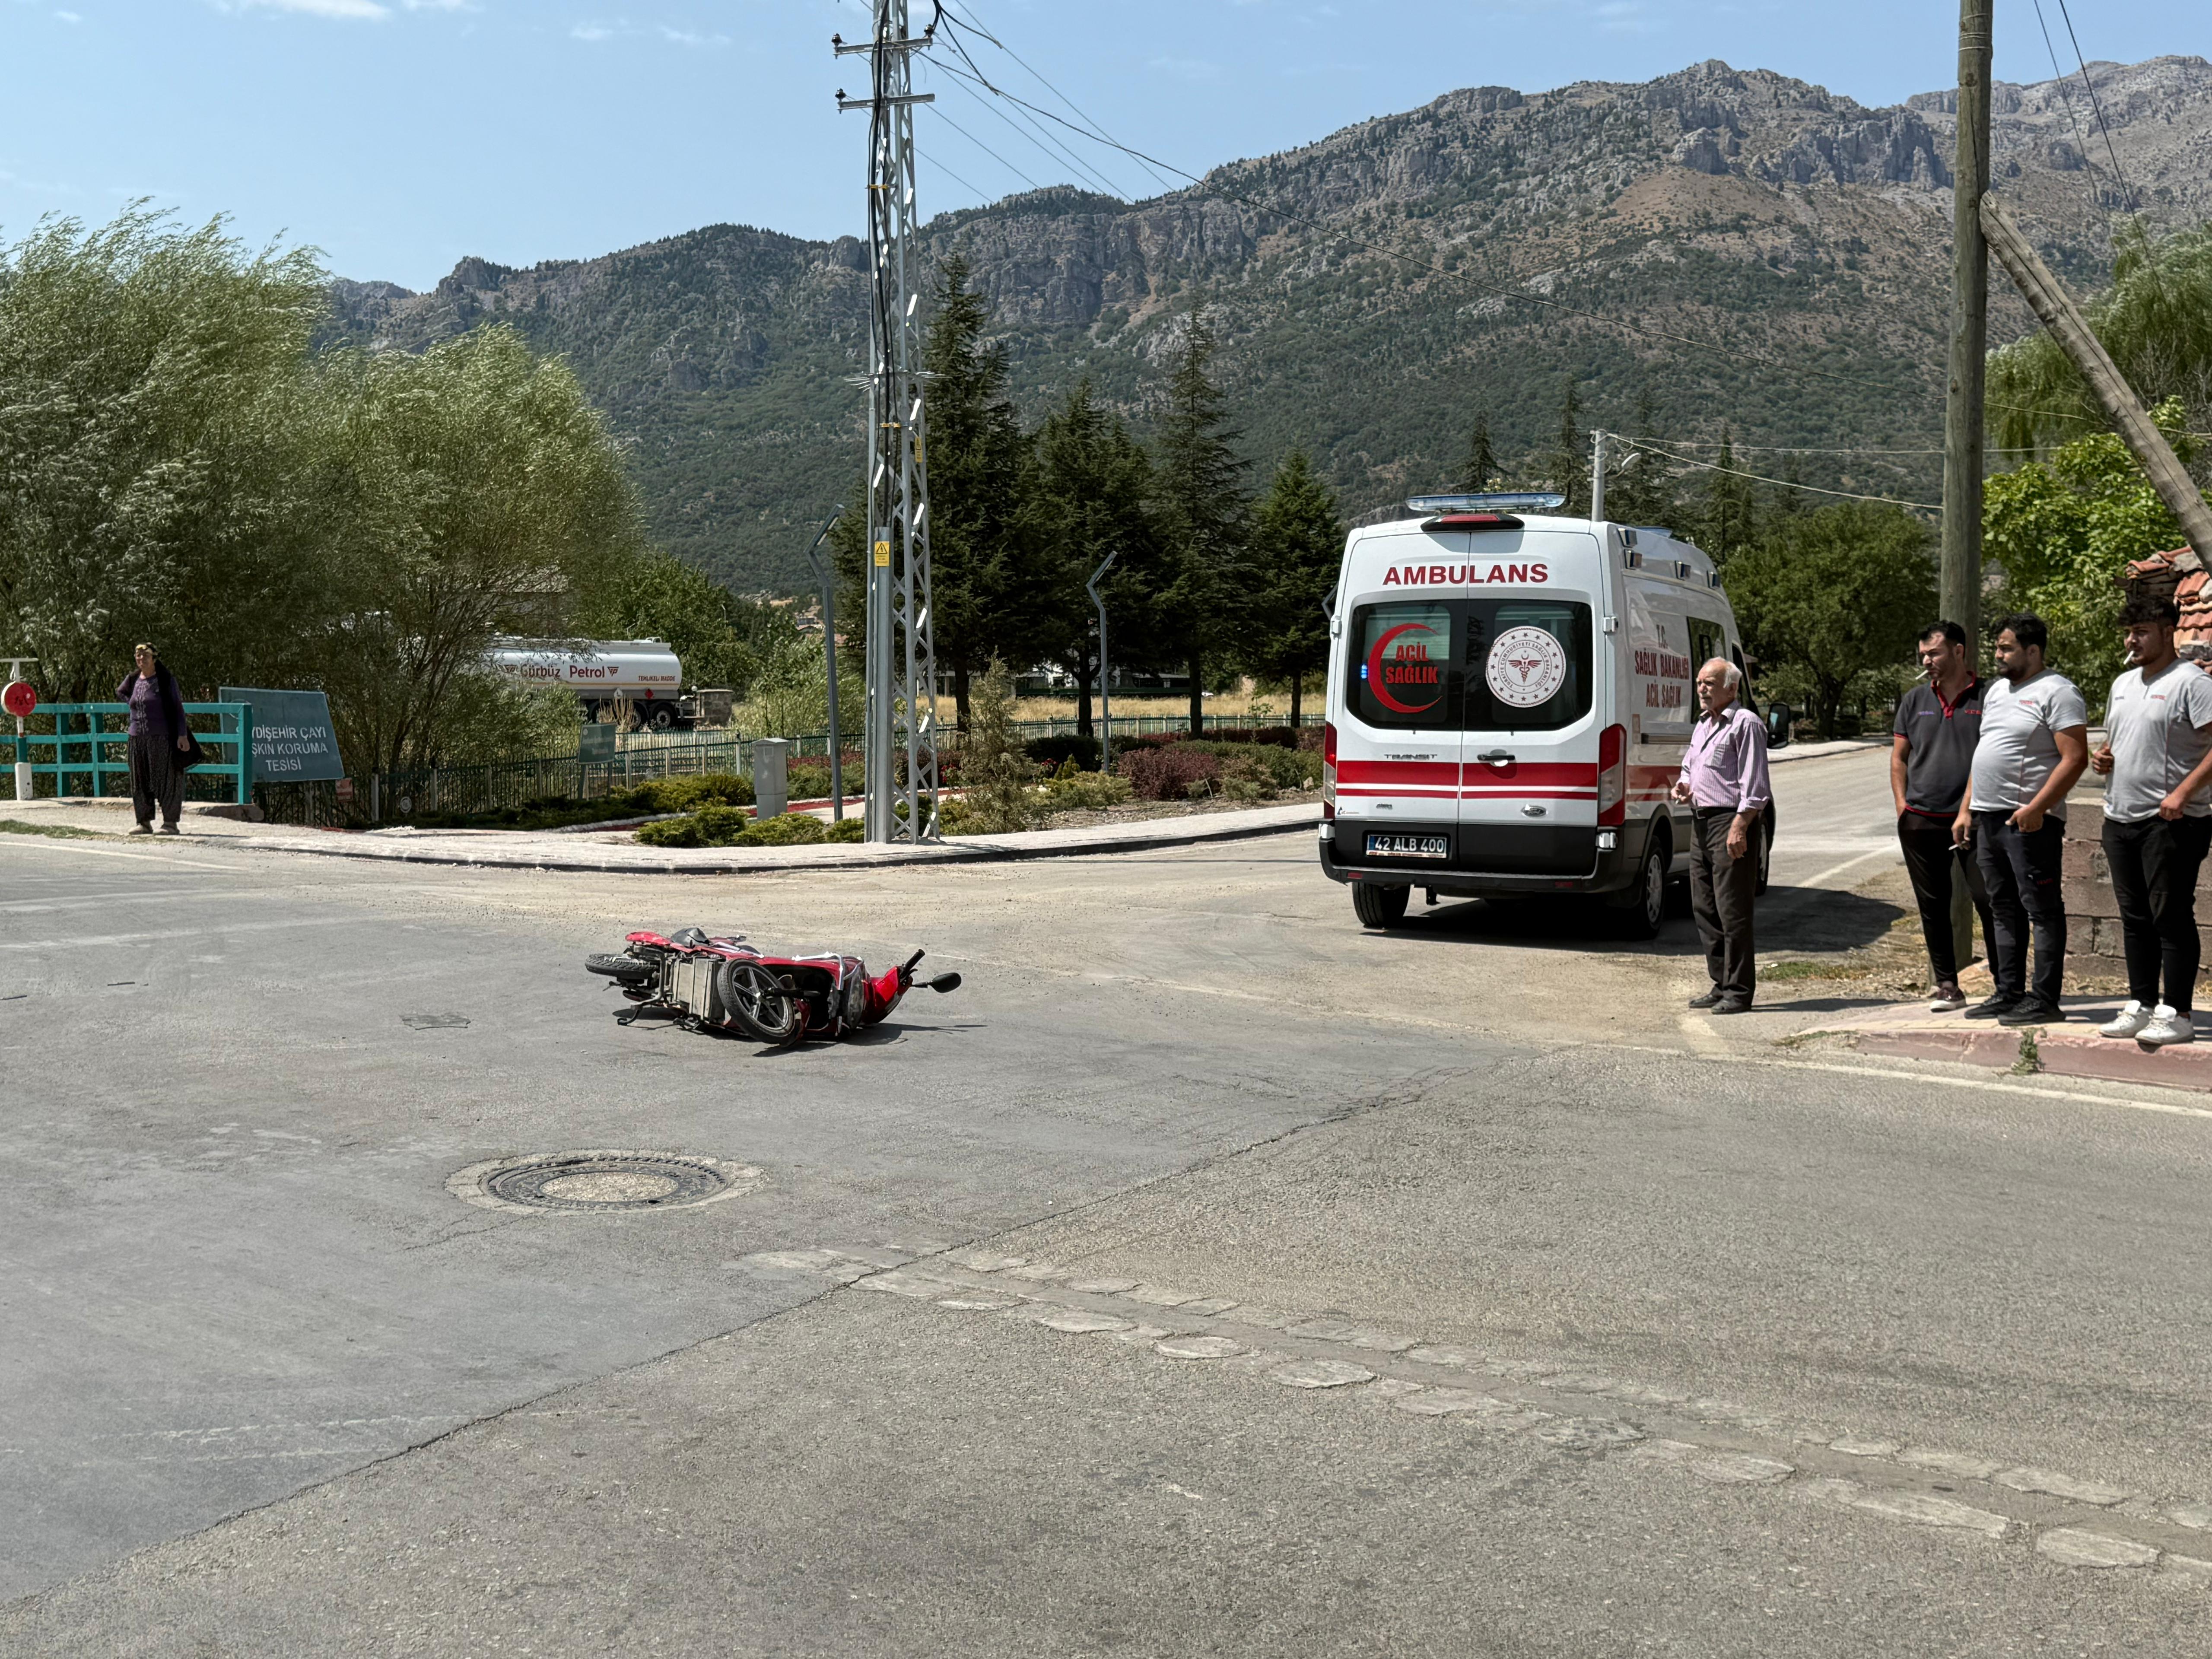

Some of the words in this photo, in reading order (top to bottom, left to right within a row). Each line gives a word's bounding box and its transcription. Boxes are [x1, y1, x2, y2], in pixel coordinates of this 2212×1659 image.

[1382, 563, 1548, 585] AMBULANS
[1395, 642, 1429, 662] ACİL
[520, 664, 561, 678] Gürbüz
[569, 665, 605, 678] Petrol
[1635, 648, 1658, 676] SAĞLIK
[1386, 664, 1438, 683] SAĞLIK
[1646, 679, 1659, 708] ACİL
[1662, 682, 1681, 709] SAĞLIK
[236, 724, 297, 741] YDİŞEHİR
[300, 726, 327, 741] ÇAYI
[252, 743, 274, 757] ŞKIN
[277, 742, 328, 755] KORUMA
[266, 756, 302, 772] TESİSİ
[1375, 837, 1390, 850] 42
[1394, 838, 1417, 851] ALB
[1421, 839, 1444, 852] 400
